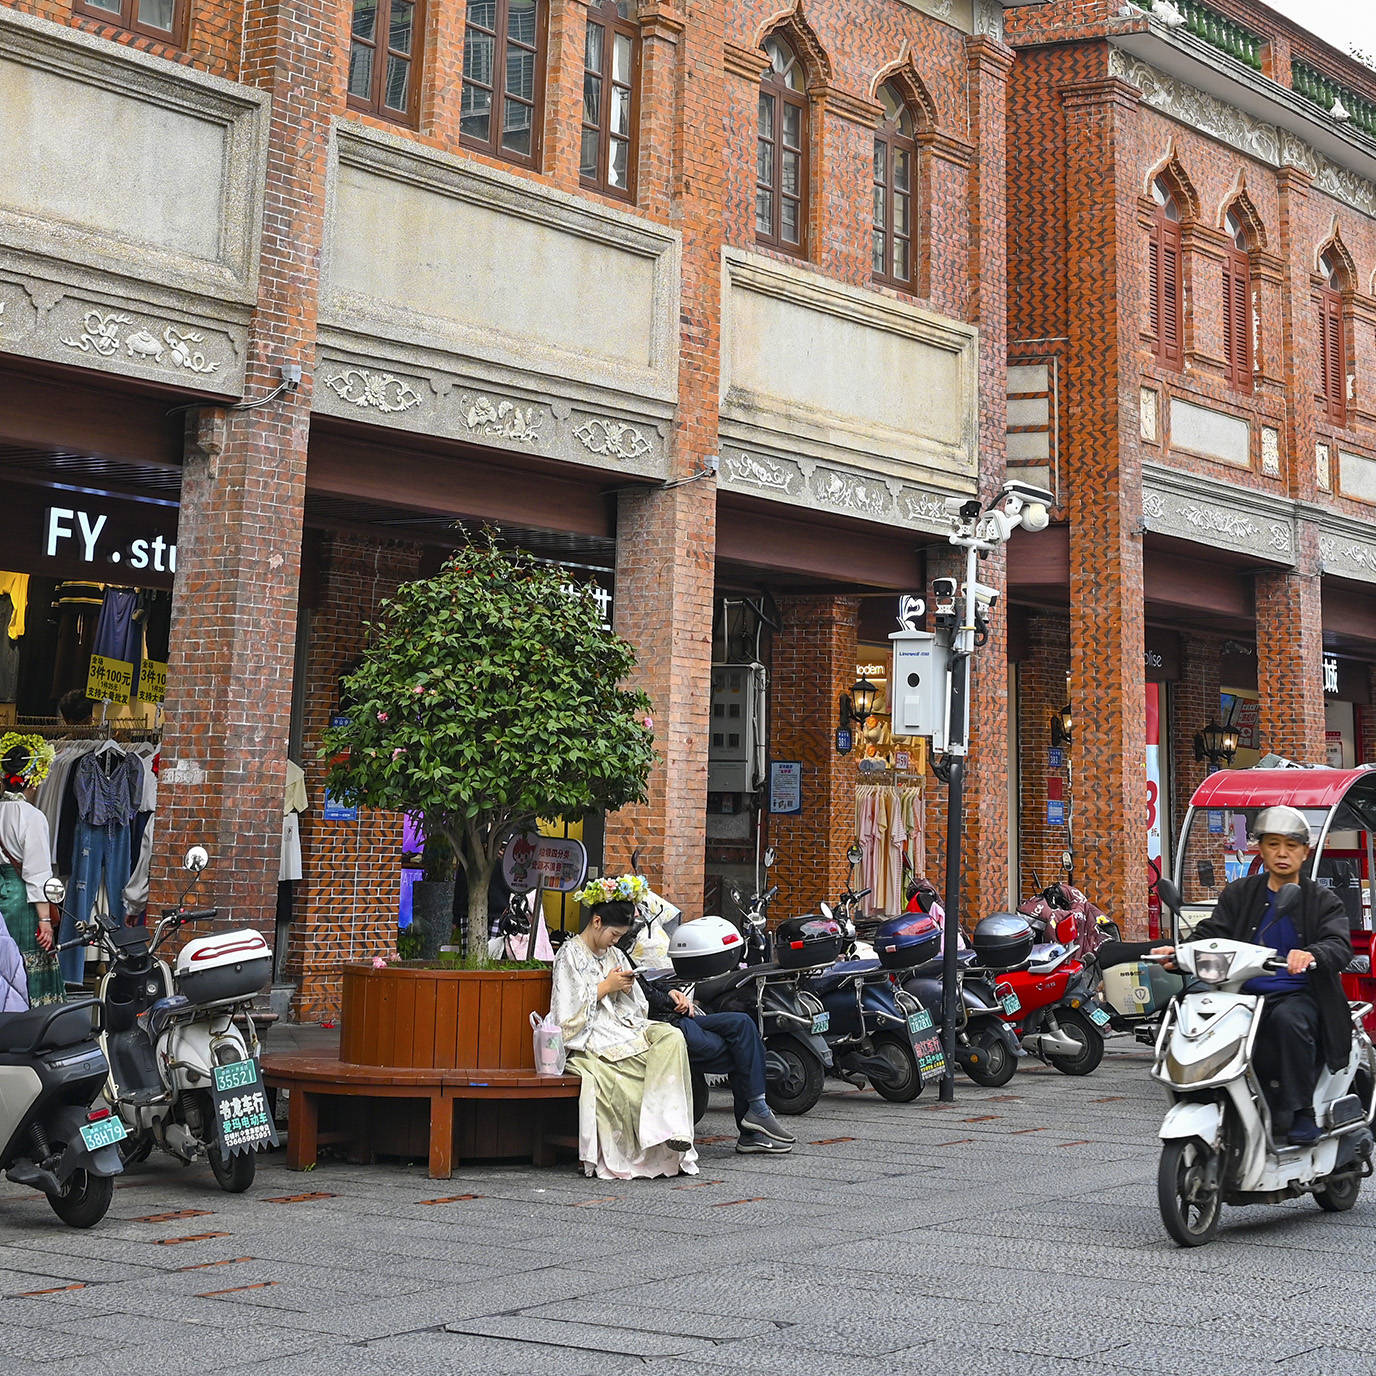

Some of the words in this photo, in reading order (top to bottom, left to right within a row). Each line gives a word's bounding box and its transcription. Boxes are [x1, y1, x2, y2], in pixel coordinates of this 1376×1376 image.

[90, 665, 131, 687] 3件100元
[218, 1069, 254, 1089] 35521
[222, 1112, 268, 1134] 爱玛电动车
[86, 1125, 122, 1148] 38H79
